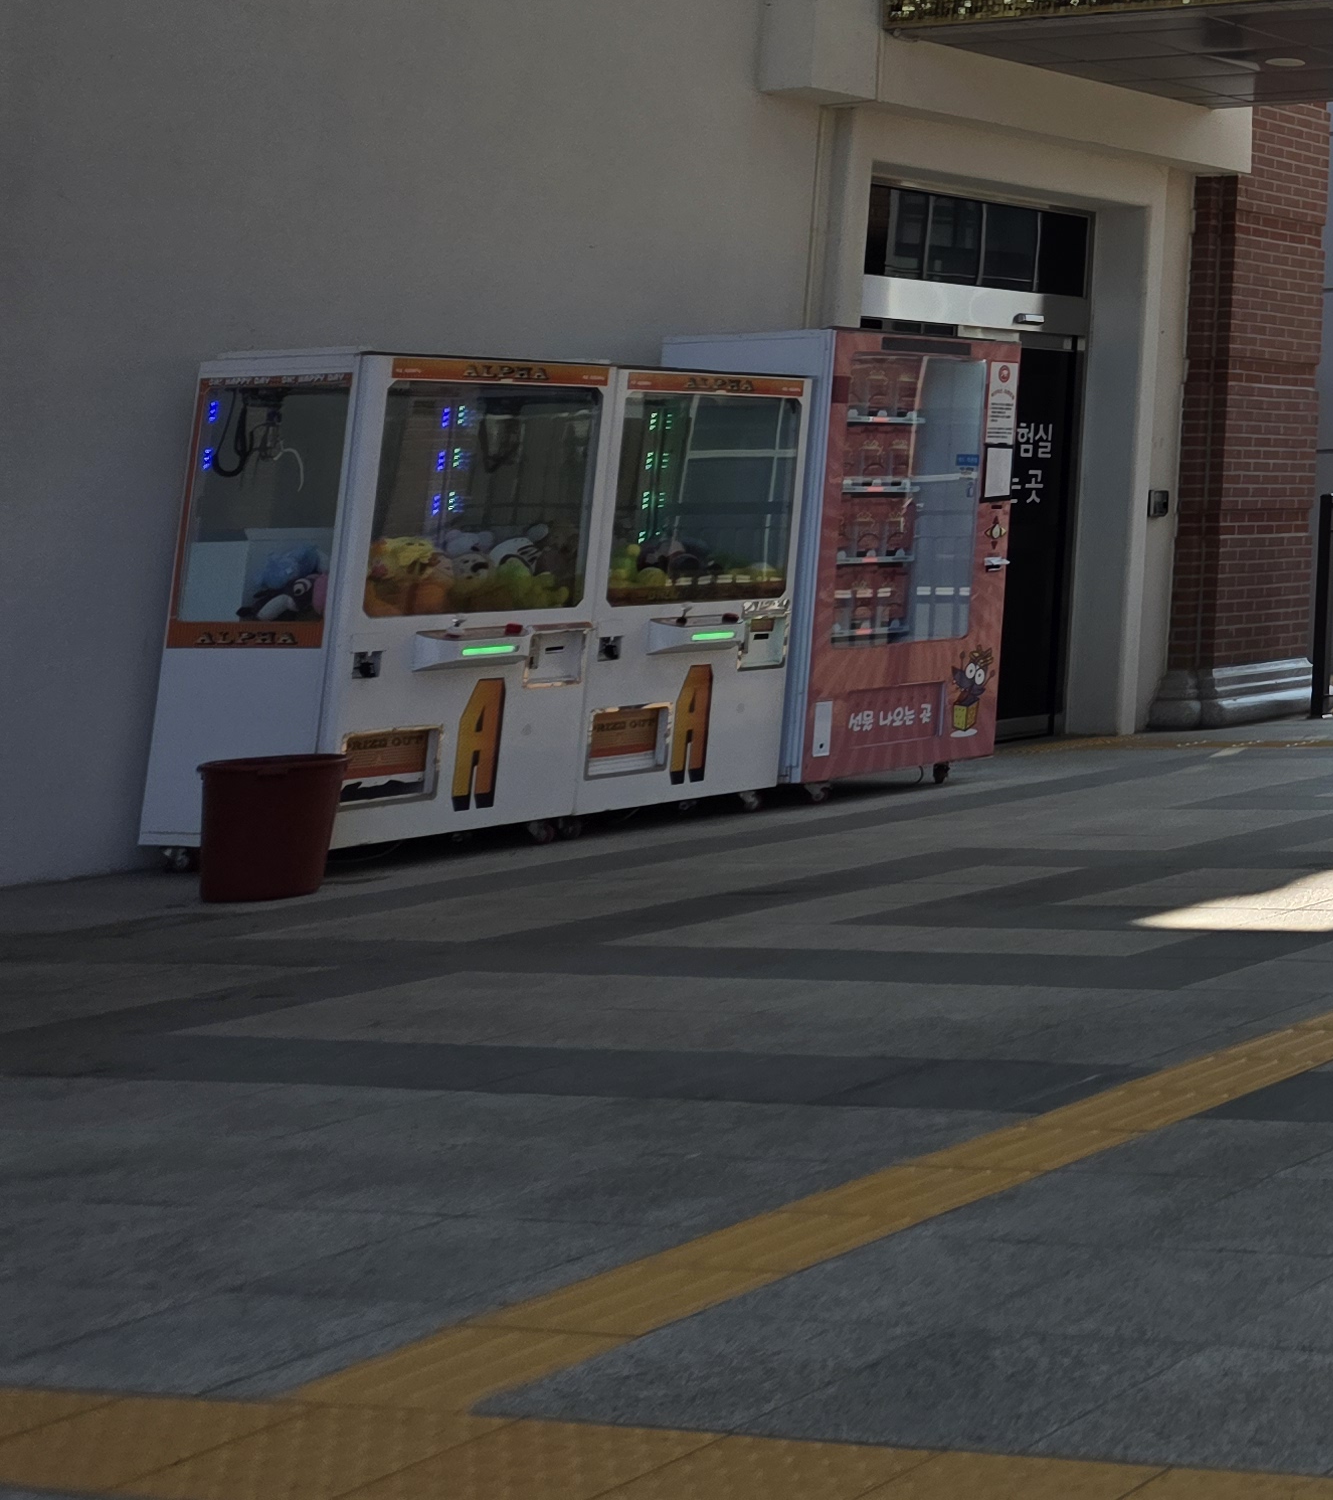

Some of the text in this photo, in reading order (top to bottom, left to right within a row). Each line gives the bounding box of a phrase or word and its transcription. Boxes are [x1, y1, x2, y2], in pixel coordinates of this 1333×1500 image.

[462, 364, 549, 381] ALPHA
[685, 377, 755, 391] ALPHA
[1025, 470, 1044, 504] 곳
[195, 631, 298, 645] ALPHA
[848, 710, 874, 732] 선물
[879, 704, 915, 727] 나오는
